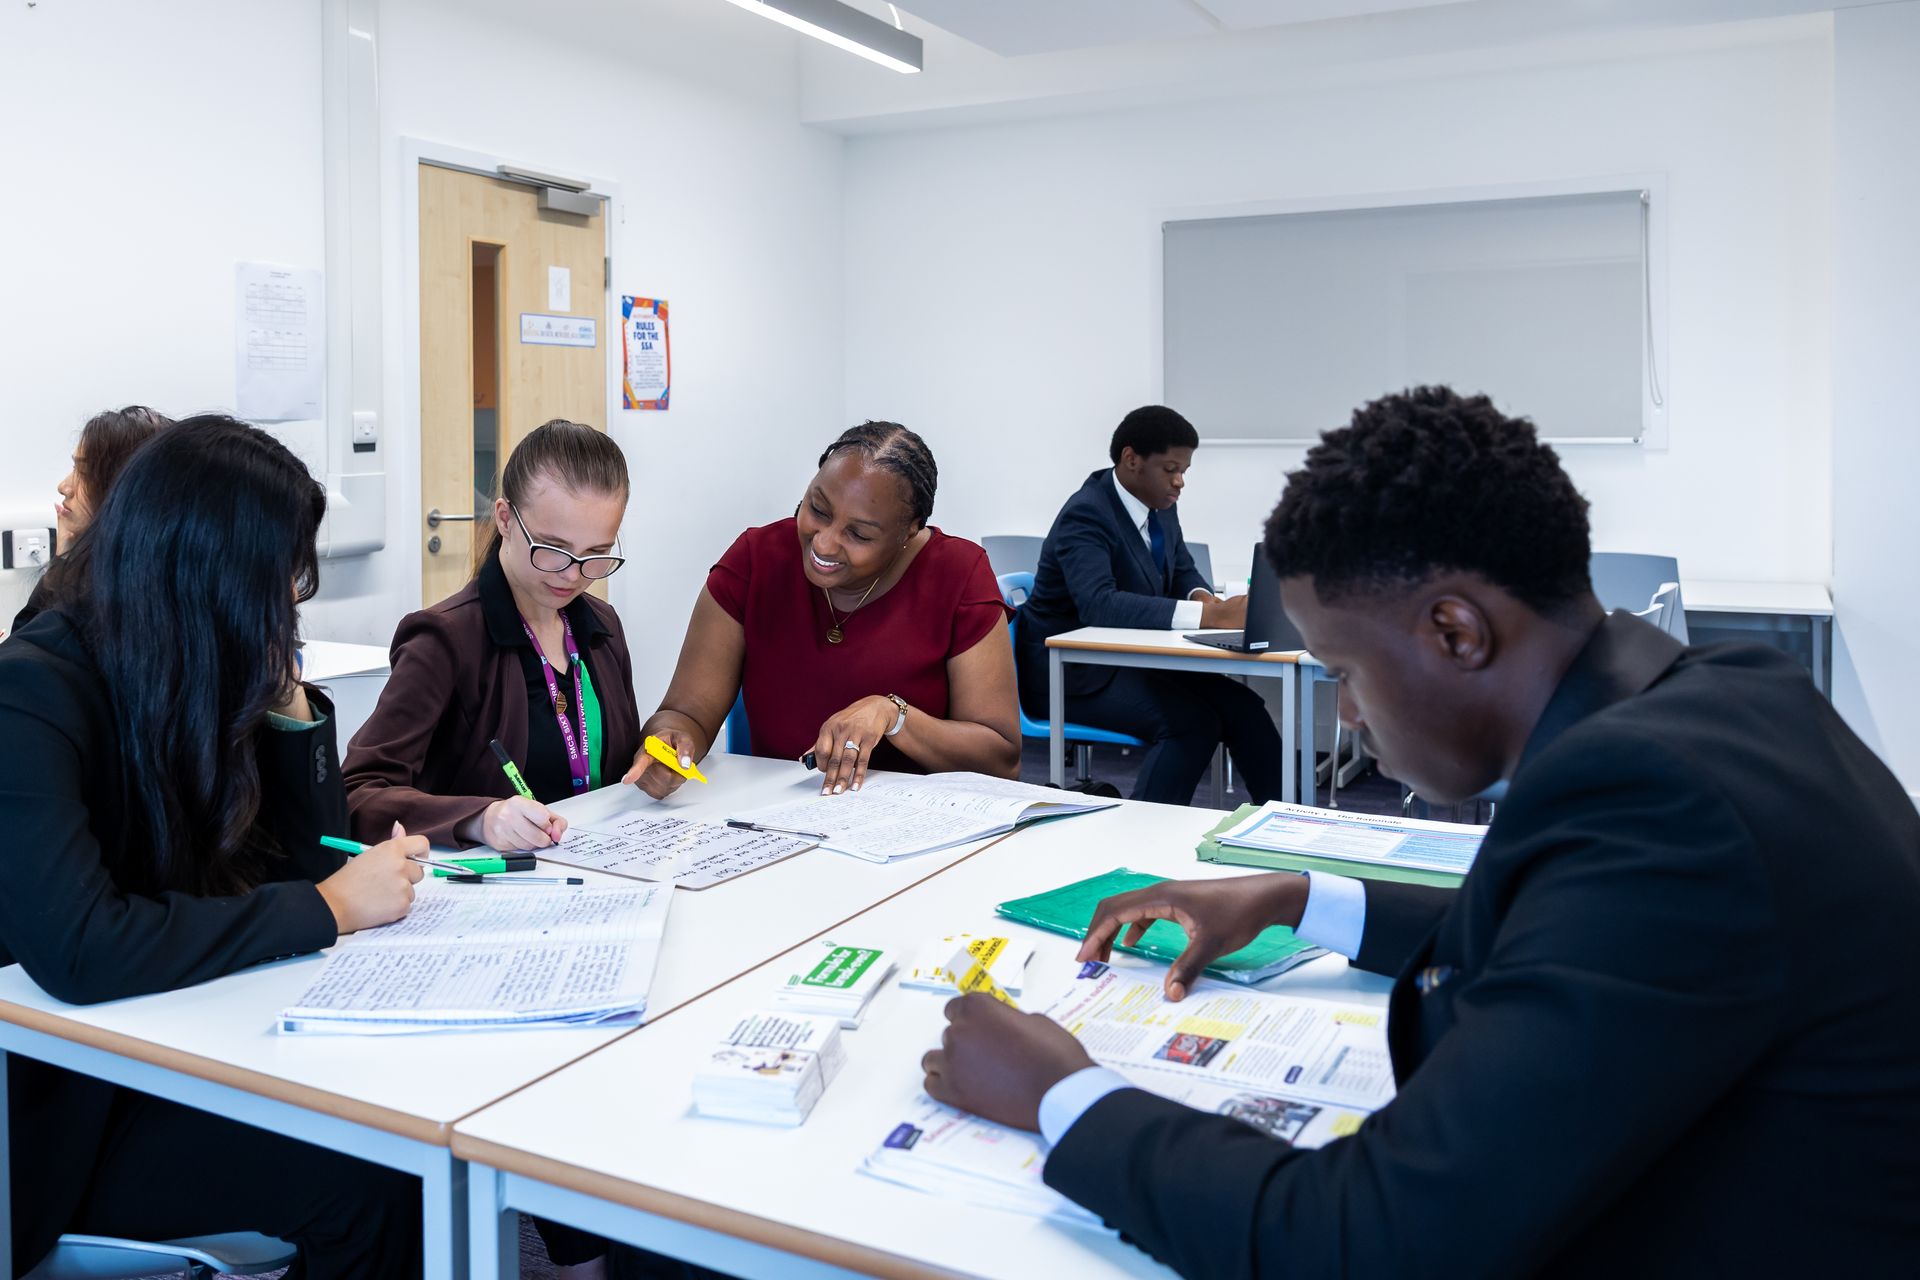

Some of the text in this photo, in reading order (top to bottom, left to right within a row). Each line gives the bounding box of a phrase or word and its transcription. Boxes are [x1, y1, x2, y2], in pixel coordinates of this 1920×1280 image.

[636, 321, 655, 331] RULES
[633, 332, 659, 341] FOR THE
[641, 342, 653, 350] SSA
[558, 713, 571, 734] SIXT
[566, 735, 578, 760] SMCS
[1285, 807, 1319, 816] Activity
[1356, 816, 1403, 825] Rationale
